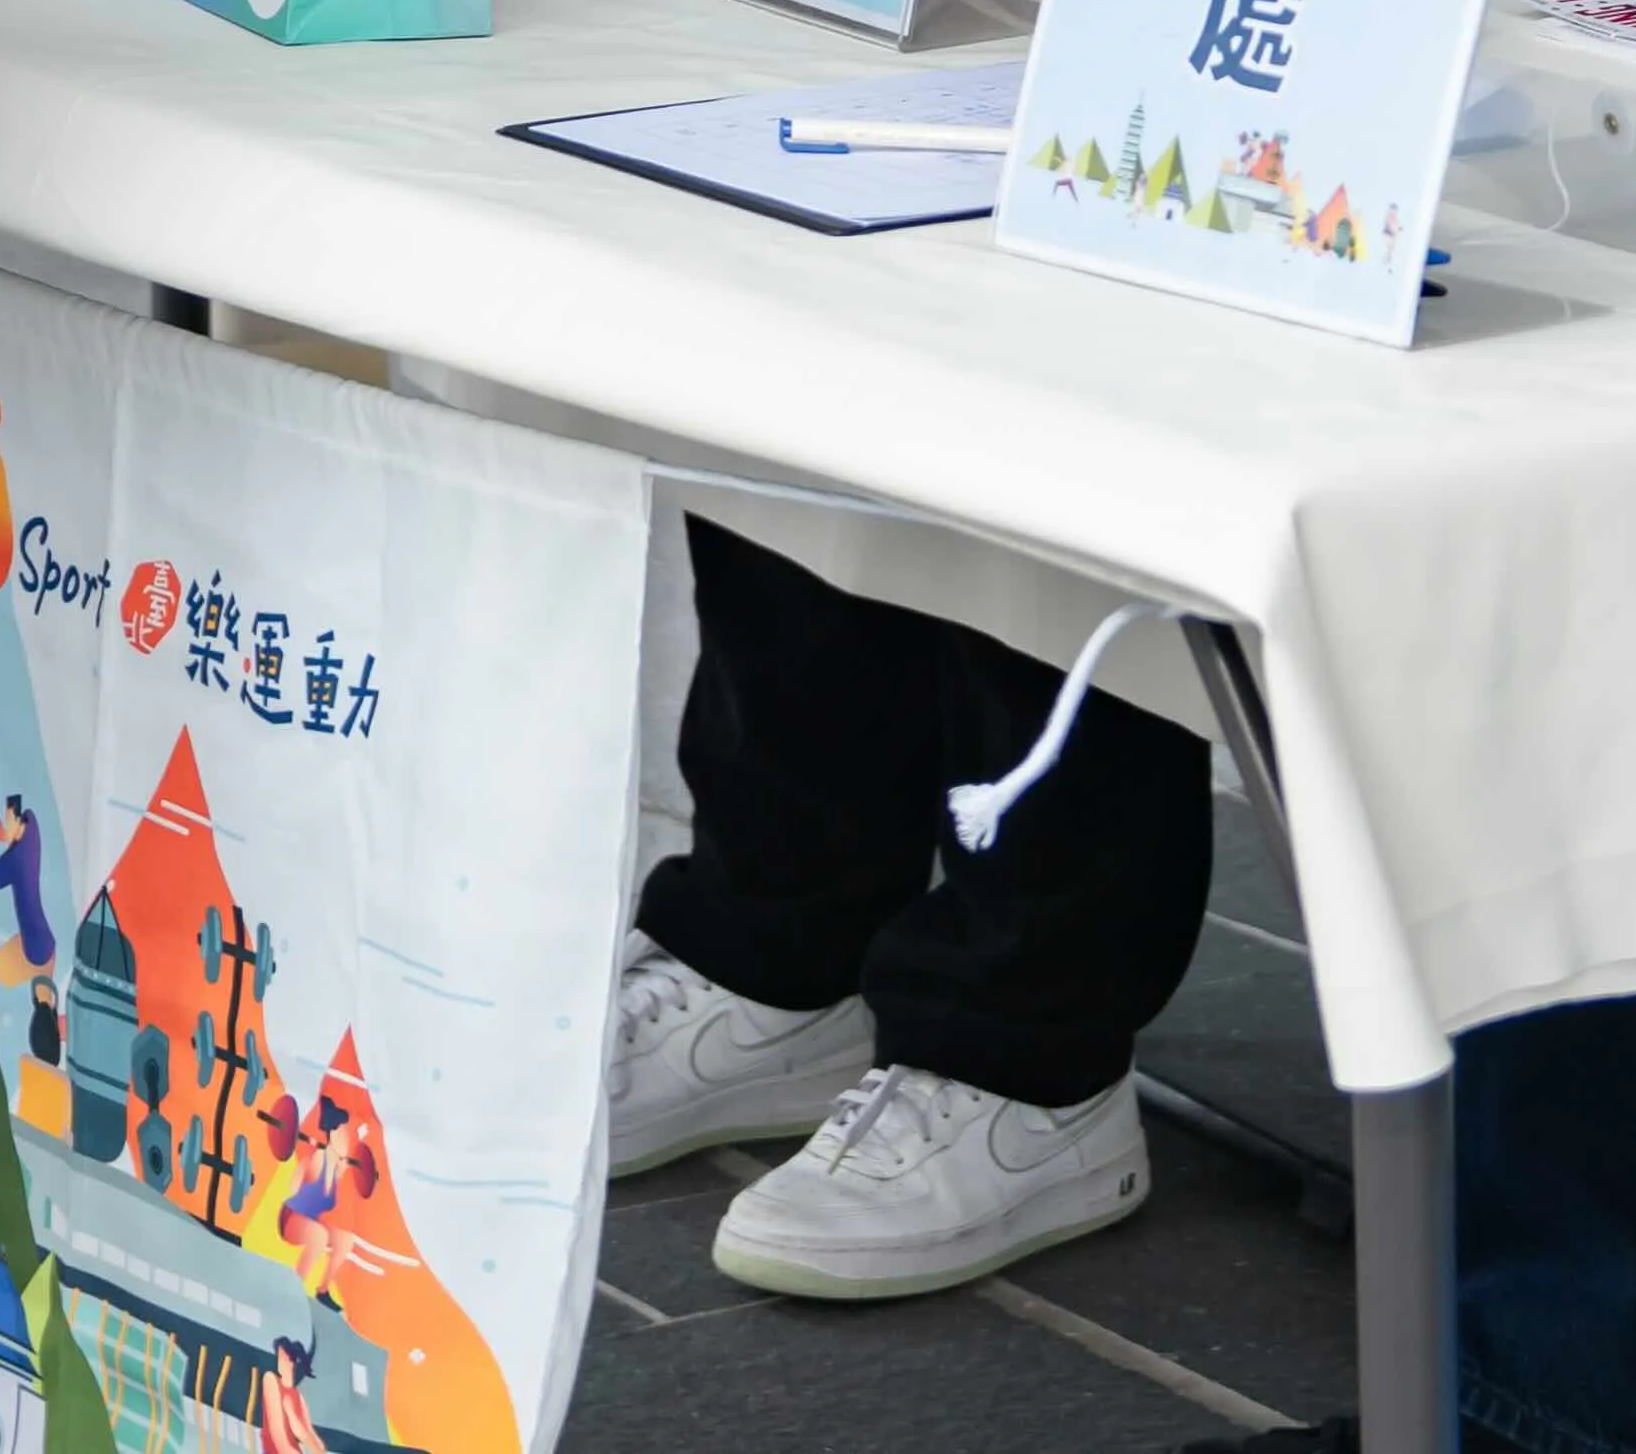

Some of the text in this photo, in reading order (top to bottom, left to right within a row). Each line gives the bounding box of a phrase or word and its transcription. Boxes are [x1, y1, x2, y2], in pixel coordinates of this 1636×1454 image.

[18, 516, 111, 627] Sport
[185, 569, 381, 739] 樂運動
